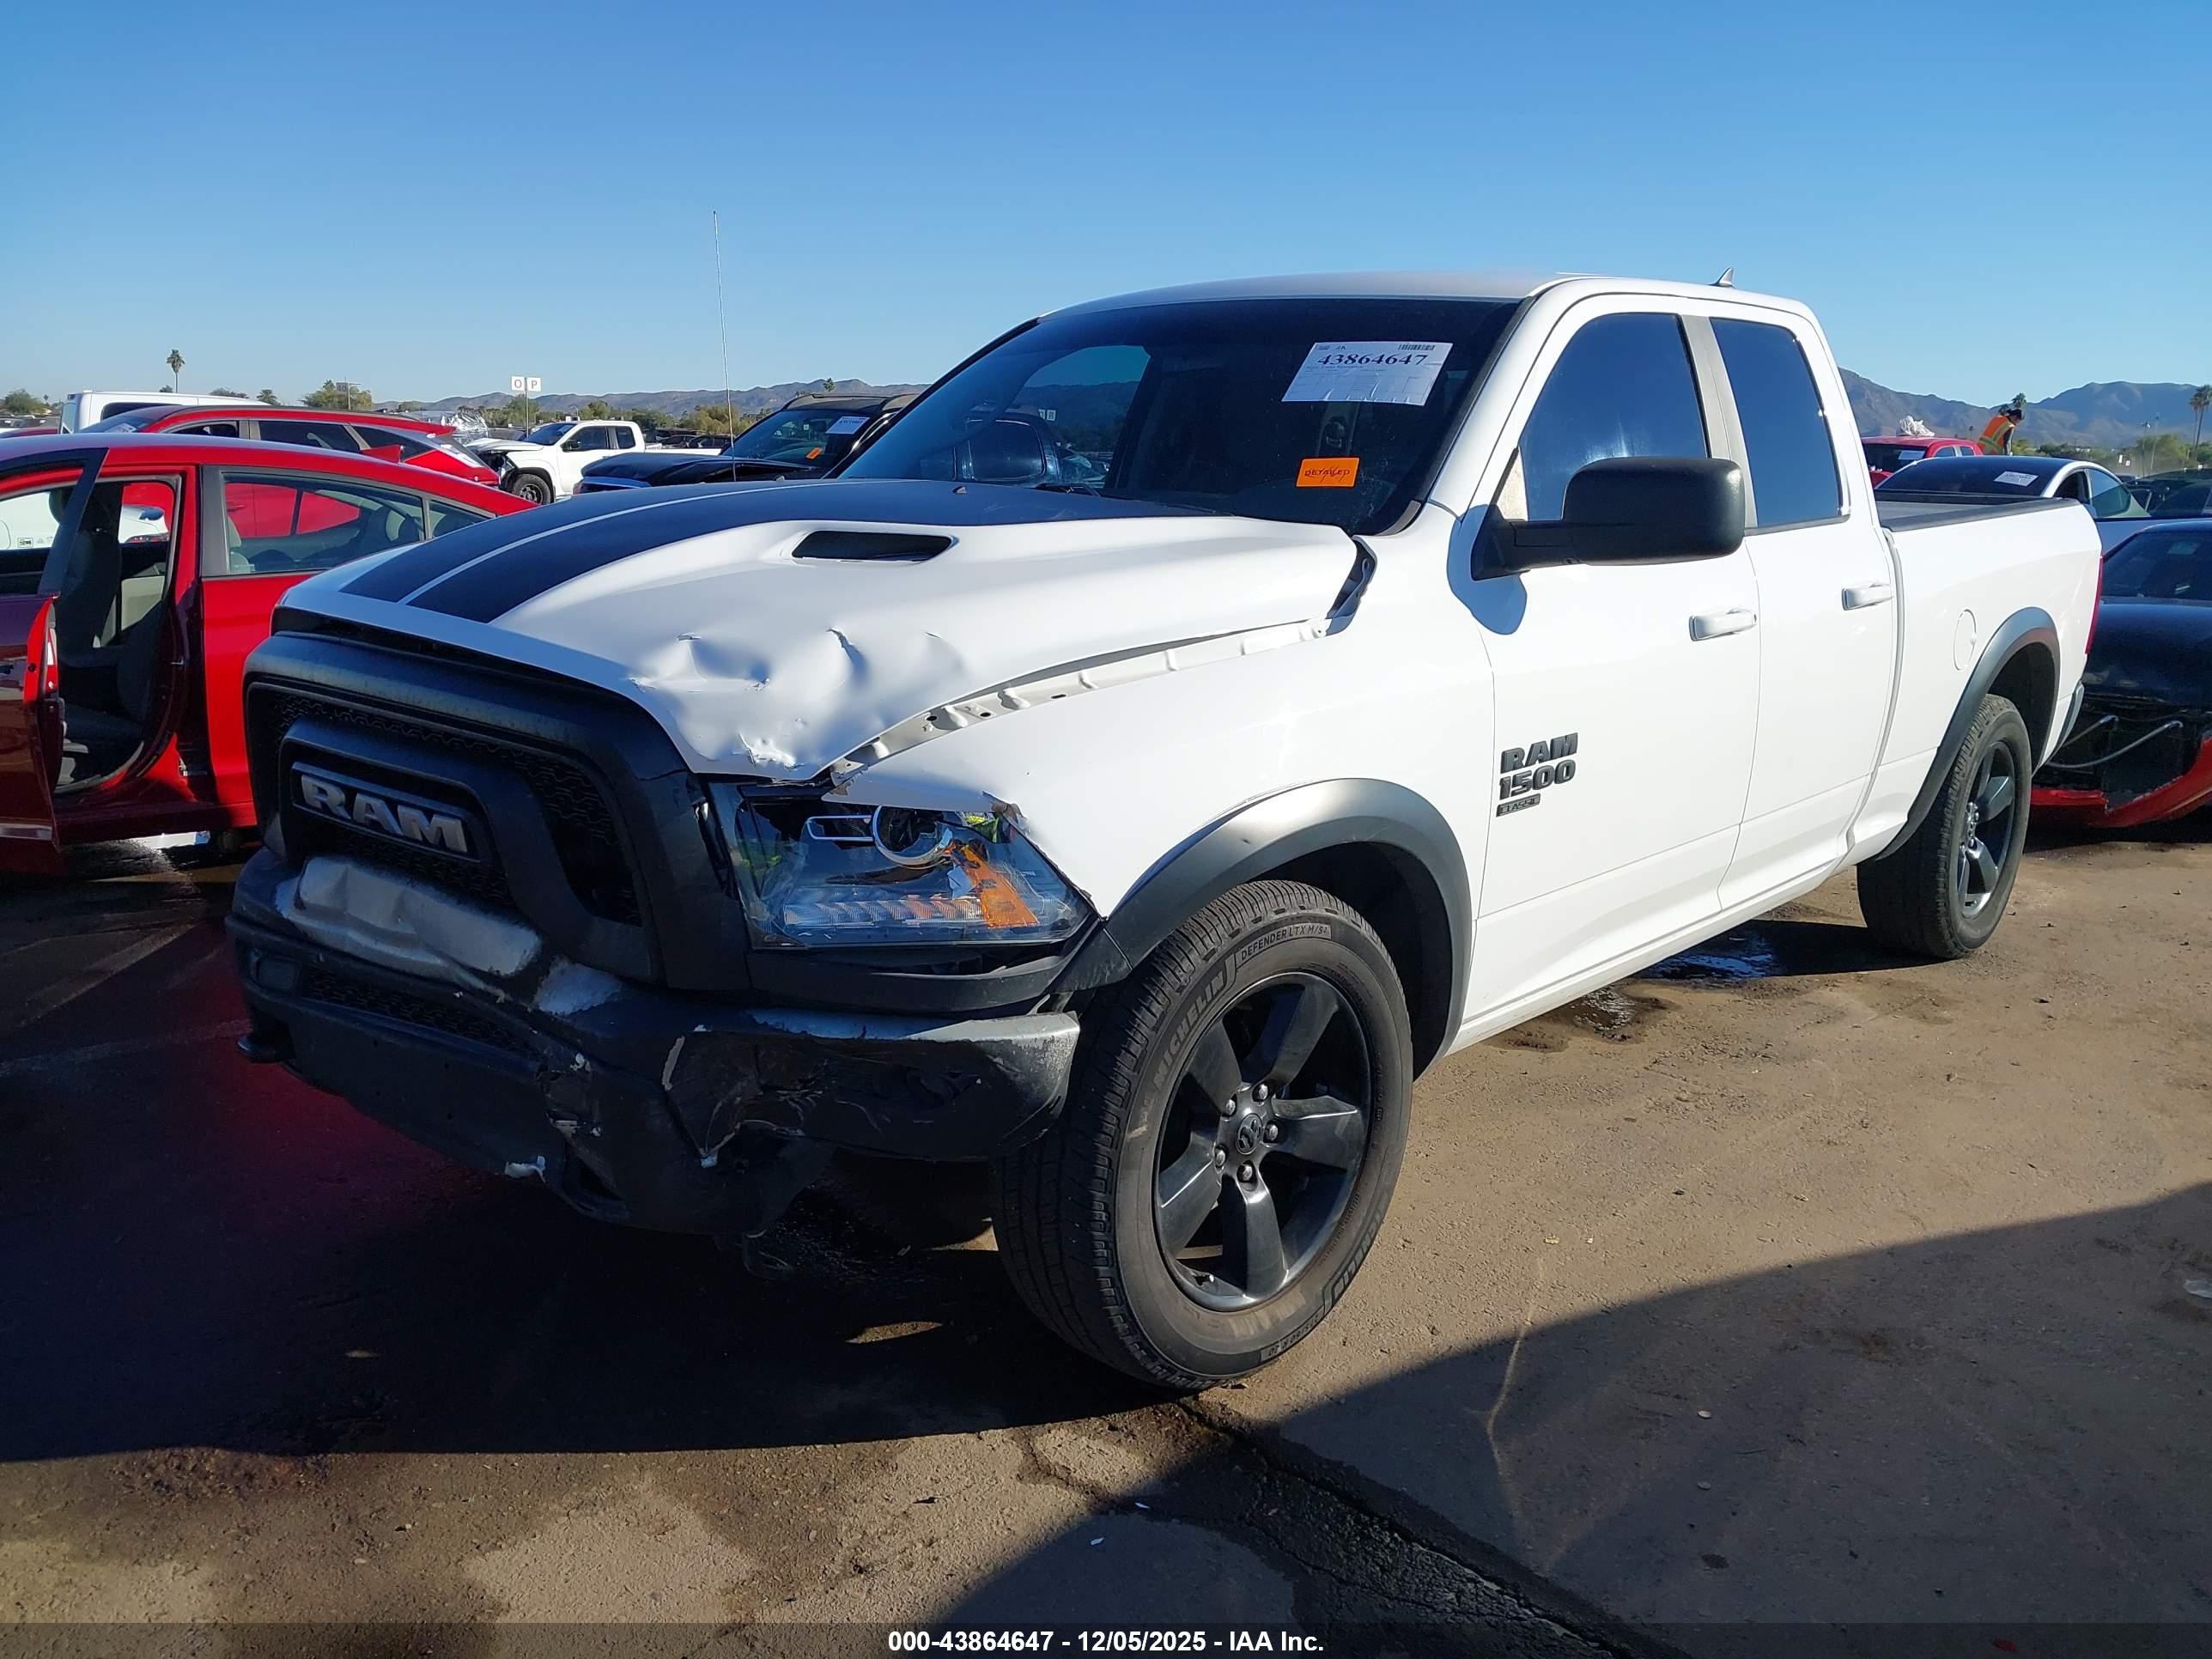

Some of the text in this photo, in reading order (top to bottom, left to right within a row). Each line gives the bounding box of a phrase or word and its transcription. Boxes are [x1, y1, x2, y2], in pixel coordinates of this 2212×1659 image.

[1317, 354, 1430, 366] 43864647
[531, 380, 538, 389] P
[1500, 732, 1578, 775] RAM
[1499, 759, 1577, 800] 1500
[301, 775, 468, 853] RAM
[1241, 928, 1287, 961] DEFENDER
[1289, 926, 1306, 937] LTX
[1153, 970, 1224, 1088] MICHELIN
